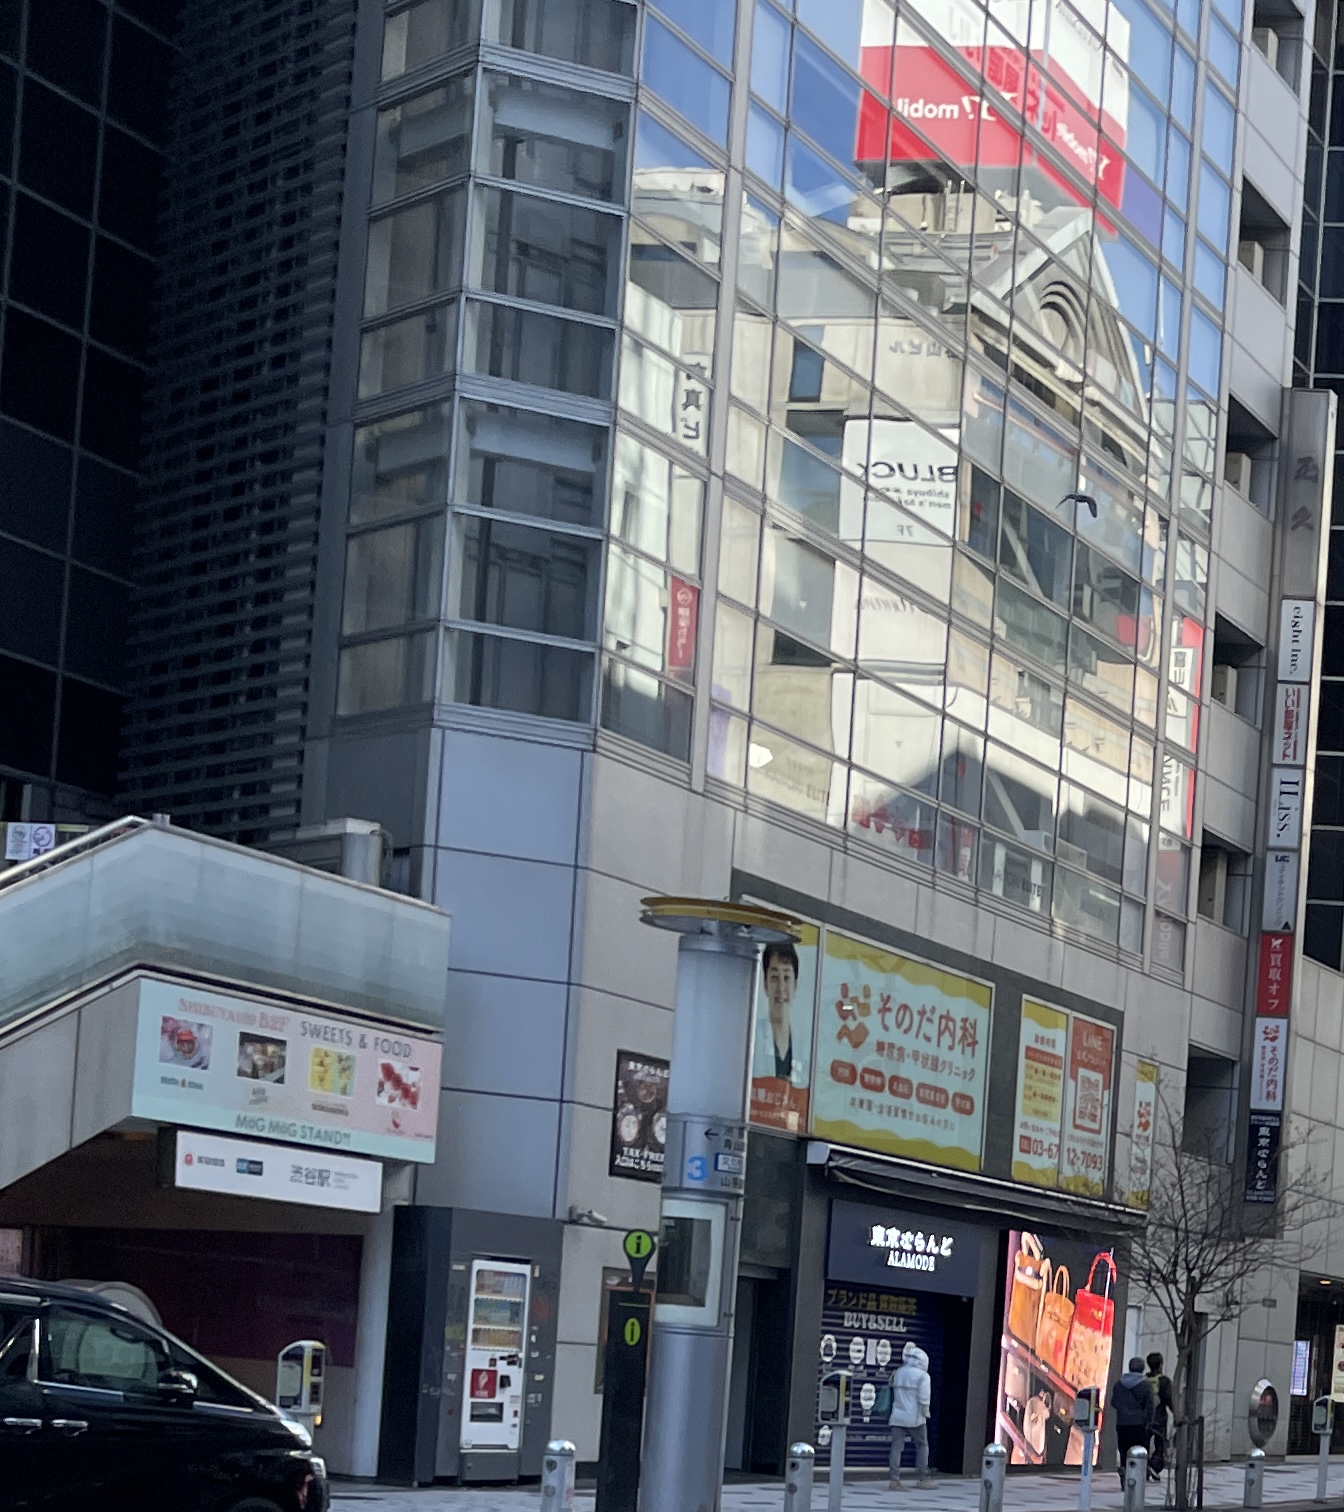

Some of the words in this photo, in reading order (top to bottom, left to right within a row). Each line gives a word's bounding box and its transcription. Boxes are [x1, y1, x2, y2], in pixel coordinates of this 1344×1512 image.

[877, 992, 979, 1058] そのだ内科
[300, 1020, 353, 1047] SWEETS
[358, 1033, 368, 1050] &
[373, 1036, 412, 1059] FOOD
[686, 1156, 709, 1182] 3
[887, 1251, 935, 1271] ALAMODE
[844, 1311, 907, 1333] BUY&SELL
